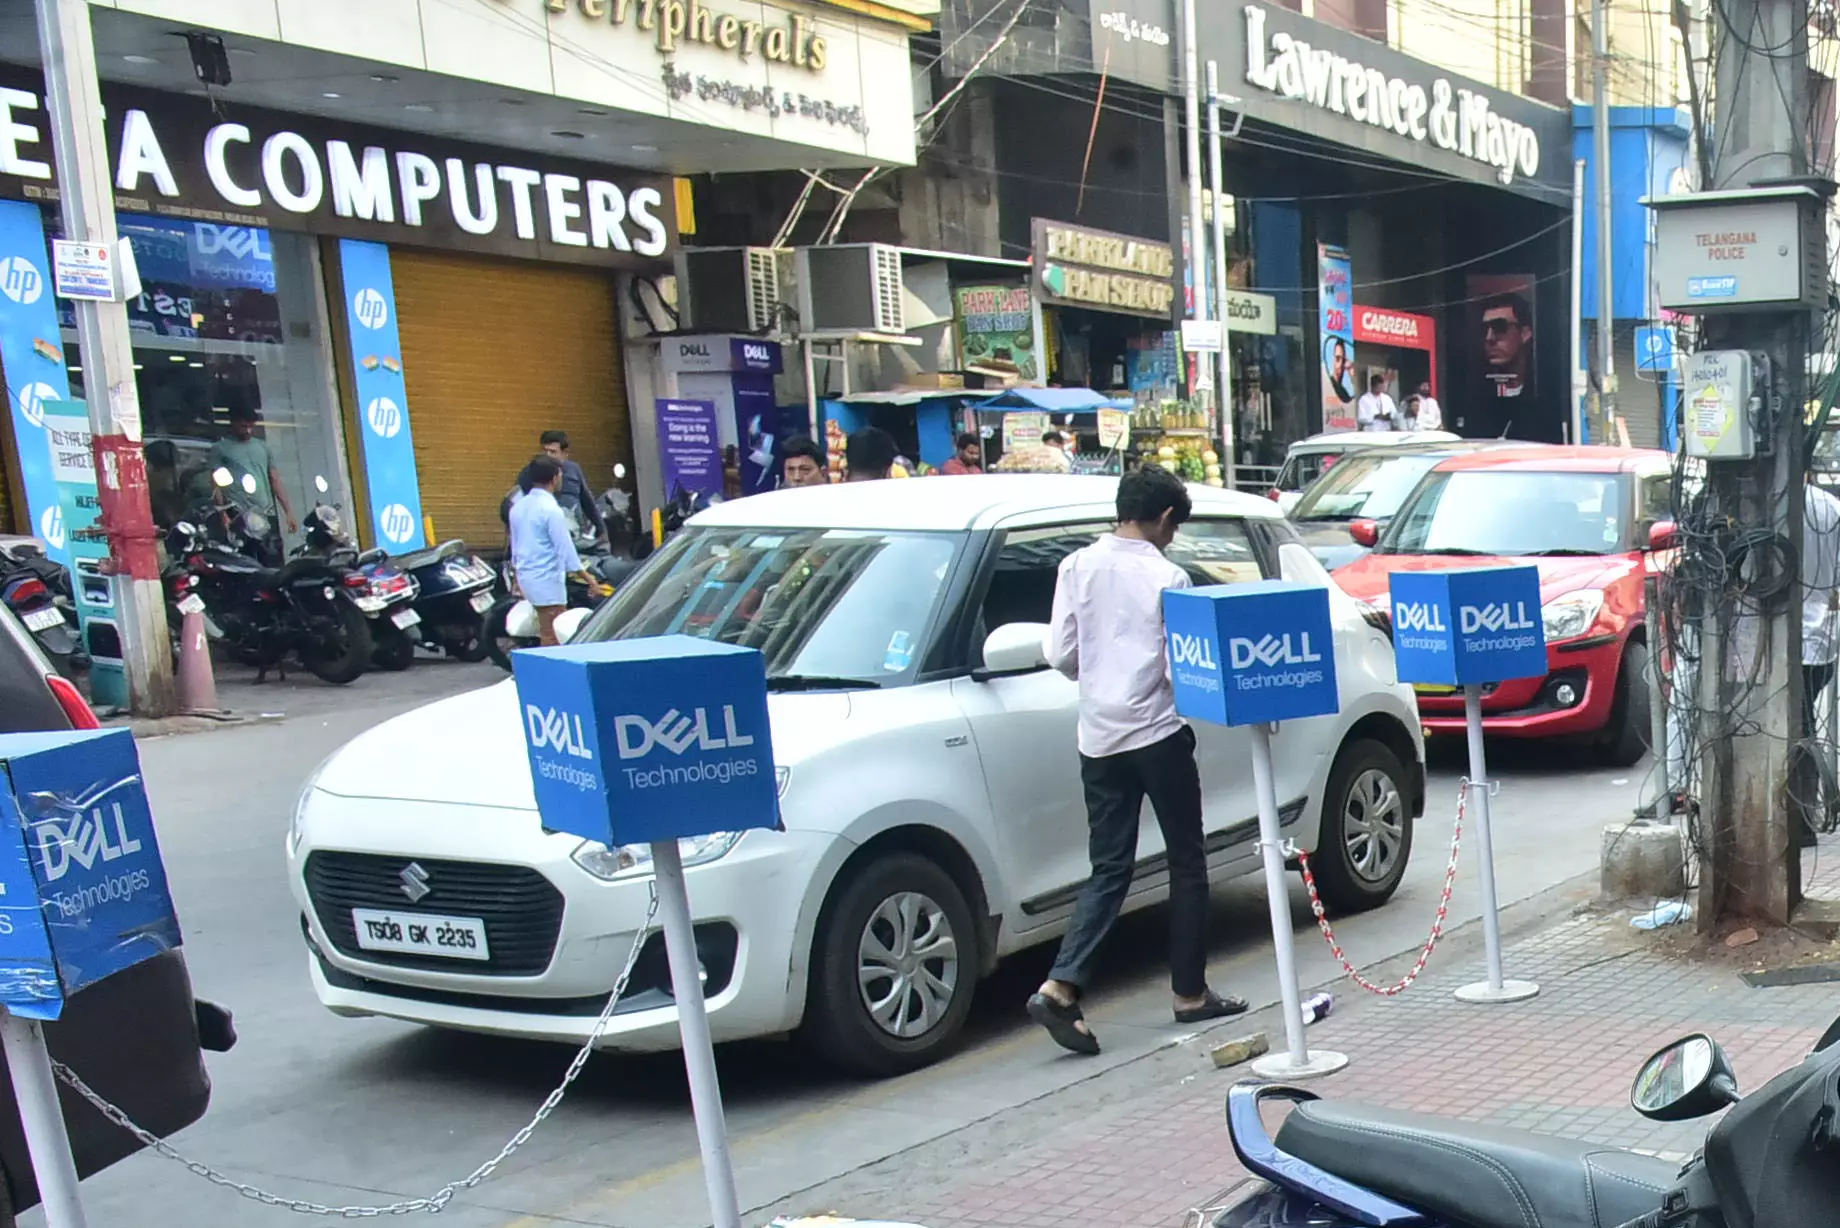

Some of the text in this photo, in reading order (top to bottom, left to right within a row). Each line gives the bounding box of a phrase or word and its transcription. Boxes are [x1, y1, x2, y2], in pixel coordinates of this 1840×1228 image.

[1245, 5, 1540, 185] Lawrence & Mayo
[204, 122, 667, 257] COMPUTERS
[1696, 232, 1757, 247] TELANGANA
[1708, 246, 1745, 260] POLICE
[3, 256, 39, 304] hp
[357, 288, 385, 329] hp
[1362, 311, 1418, 337] CARRERA
[680, 344, 710, 357] DELL
[744, 344, 770, 360] DELL
[372, 397, 398, 438] hp
[385, 504, 410, 544] hp
[1395, 601, 1446, 633] DELL
[1460, 600, 1534, 634] DELL
[1171, 632, 1217, 670] DELL
[1229, 631, 1322, 670] DELL
[1399, 631, 1448, 653] Technologies
[1463, 632, 1536, 653] Technologies
[1176, 667, 1219, 692] Technologies
[1232, 668, 1323, 691] Technologies
[526, 703, 593, 760] DELL
[614, 704, 754, 760] DELL
[536, 754, 597, 791] Technologies
[622, 756, 758, 790] Technologies
[35, 802, 142, 882] DELL
[52, 867, 150, 920] Technologies
[364, 919, 477, 949] TS08 GK 2235
